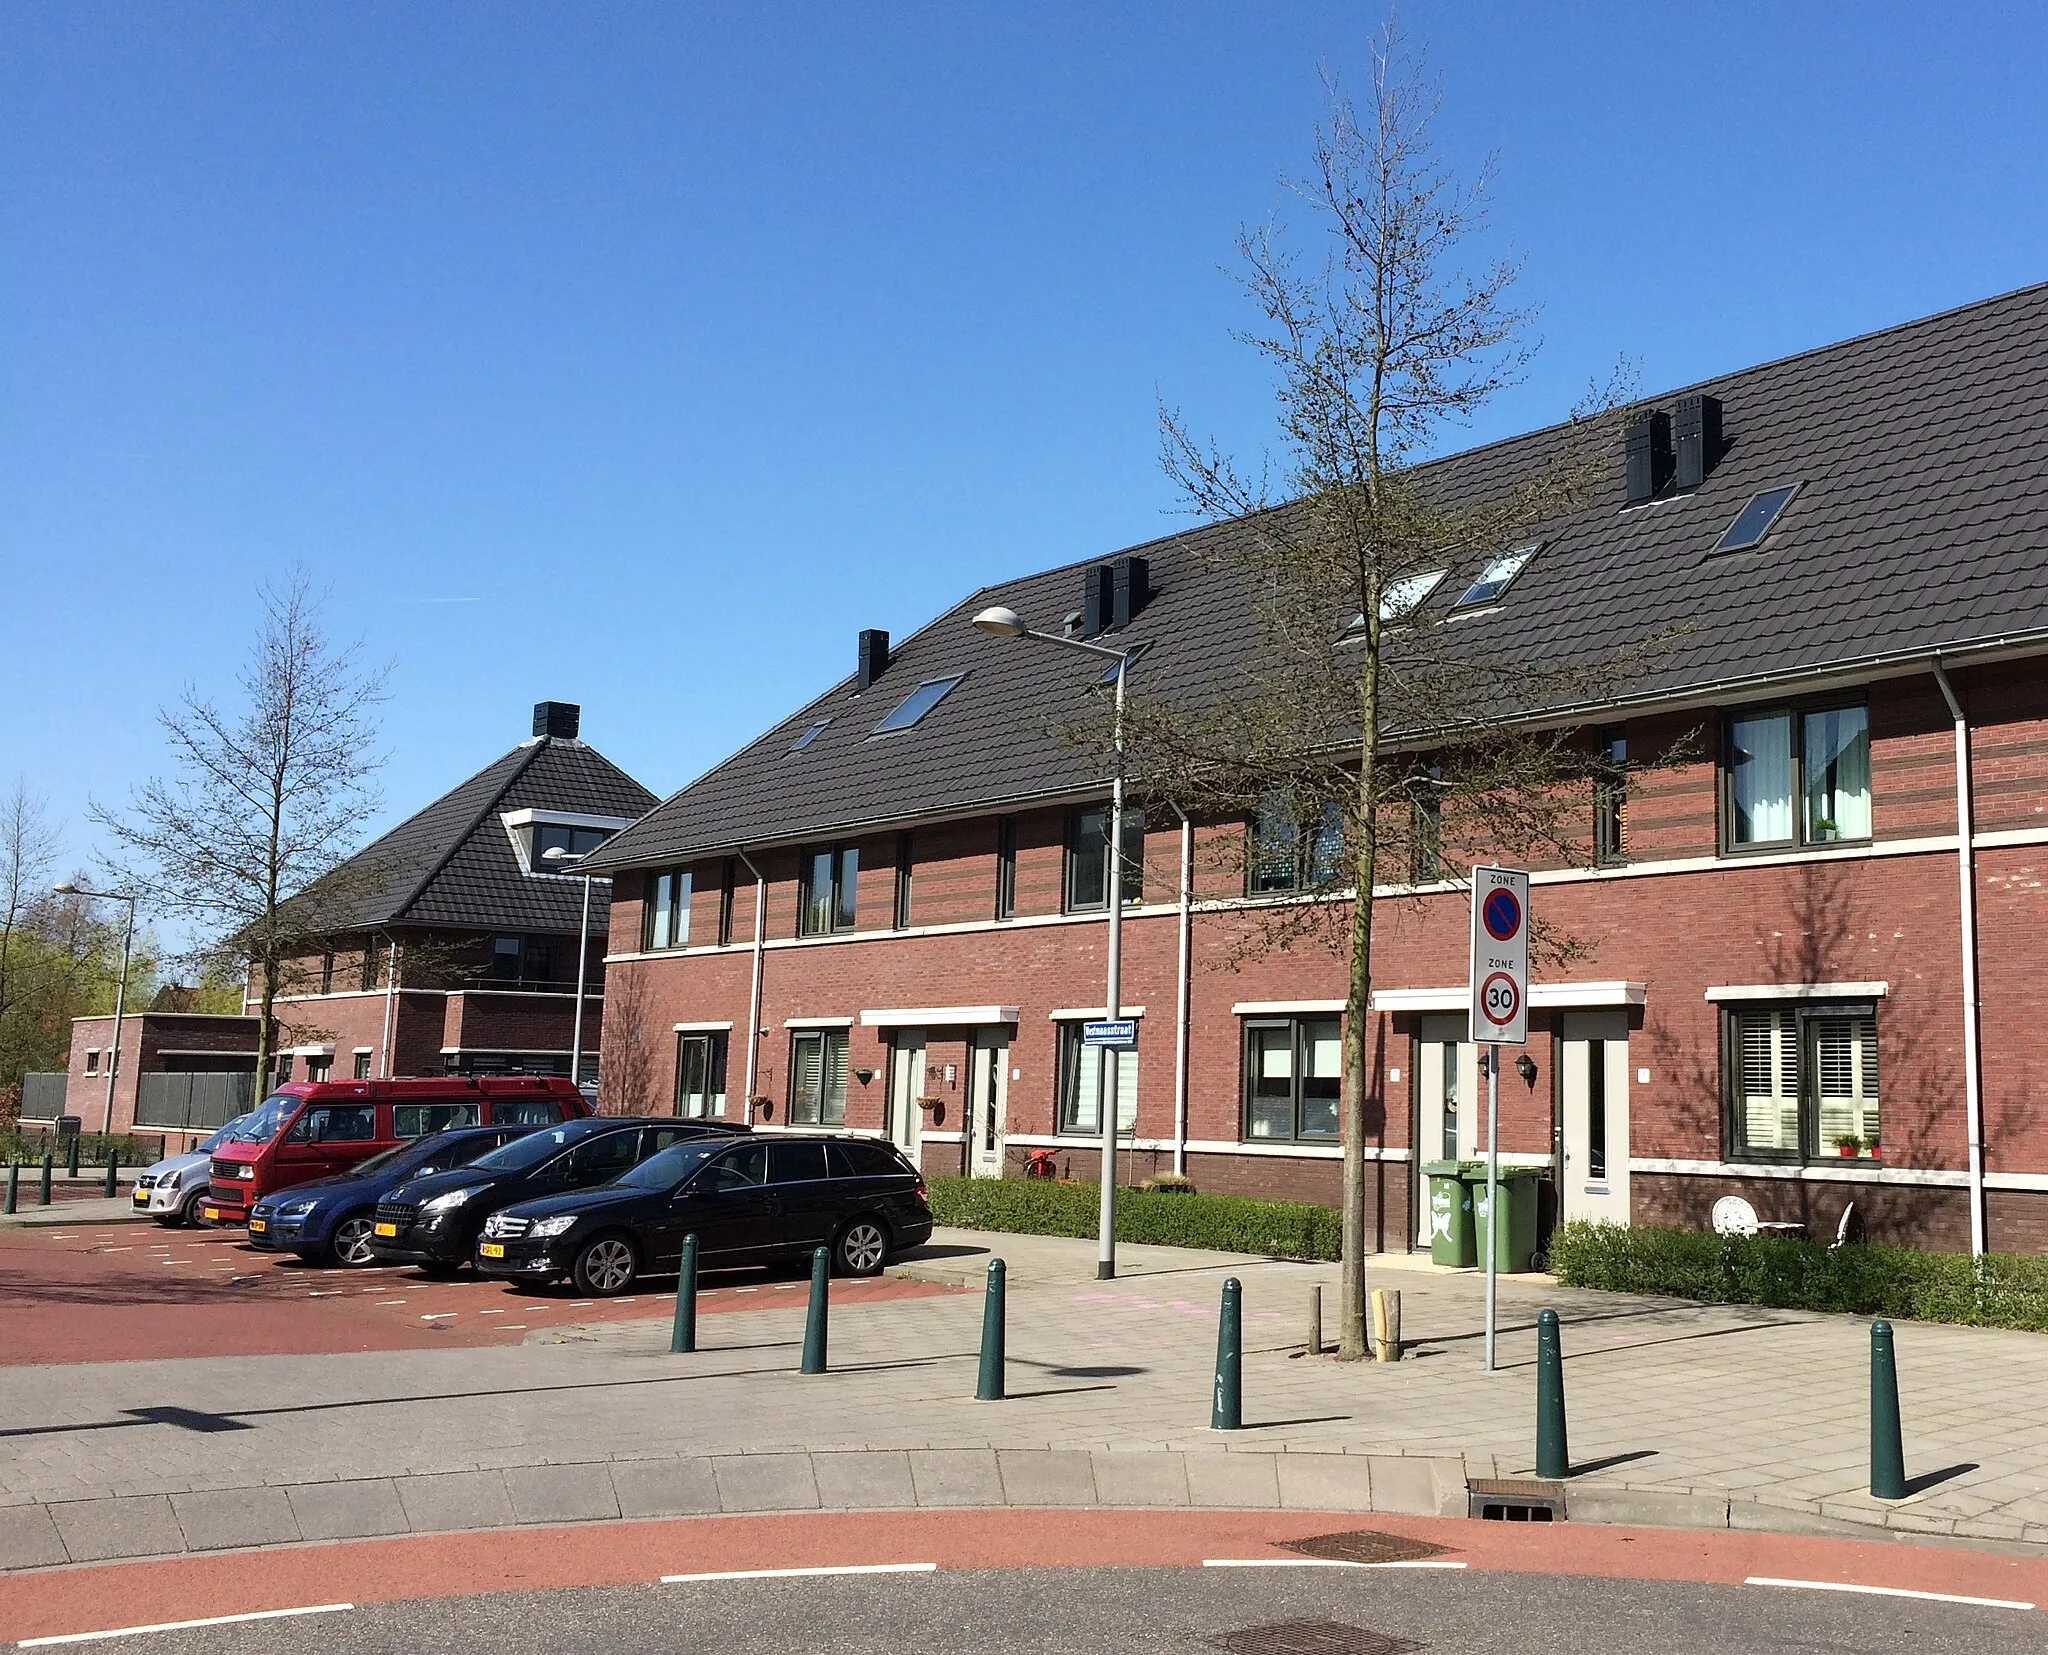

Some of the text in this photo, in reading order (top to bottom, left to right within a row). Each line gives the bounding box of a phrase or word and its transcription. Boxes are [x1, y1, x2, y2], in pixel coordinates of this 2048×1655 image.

[1490, 874, 1516, 886] ZONE
[1488, 958, 1514, 970] ZONE
[1488, 988, 1513, 1009] 30
